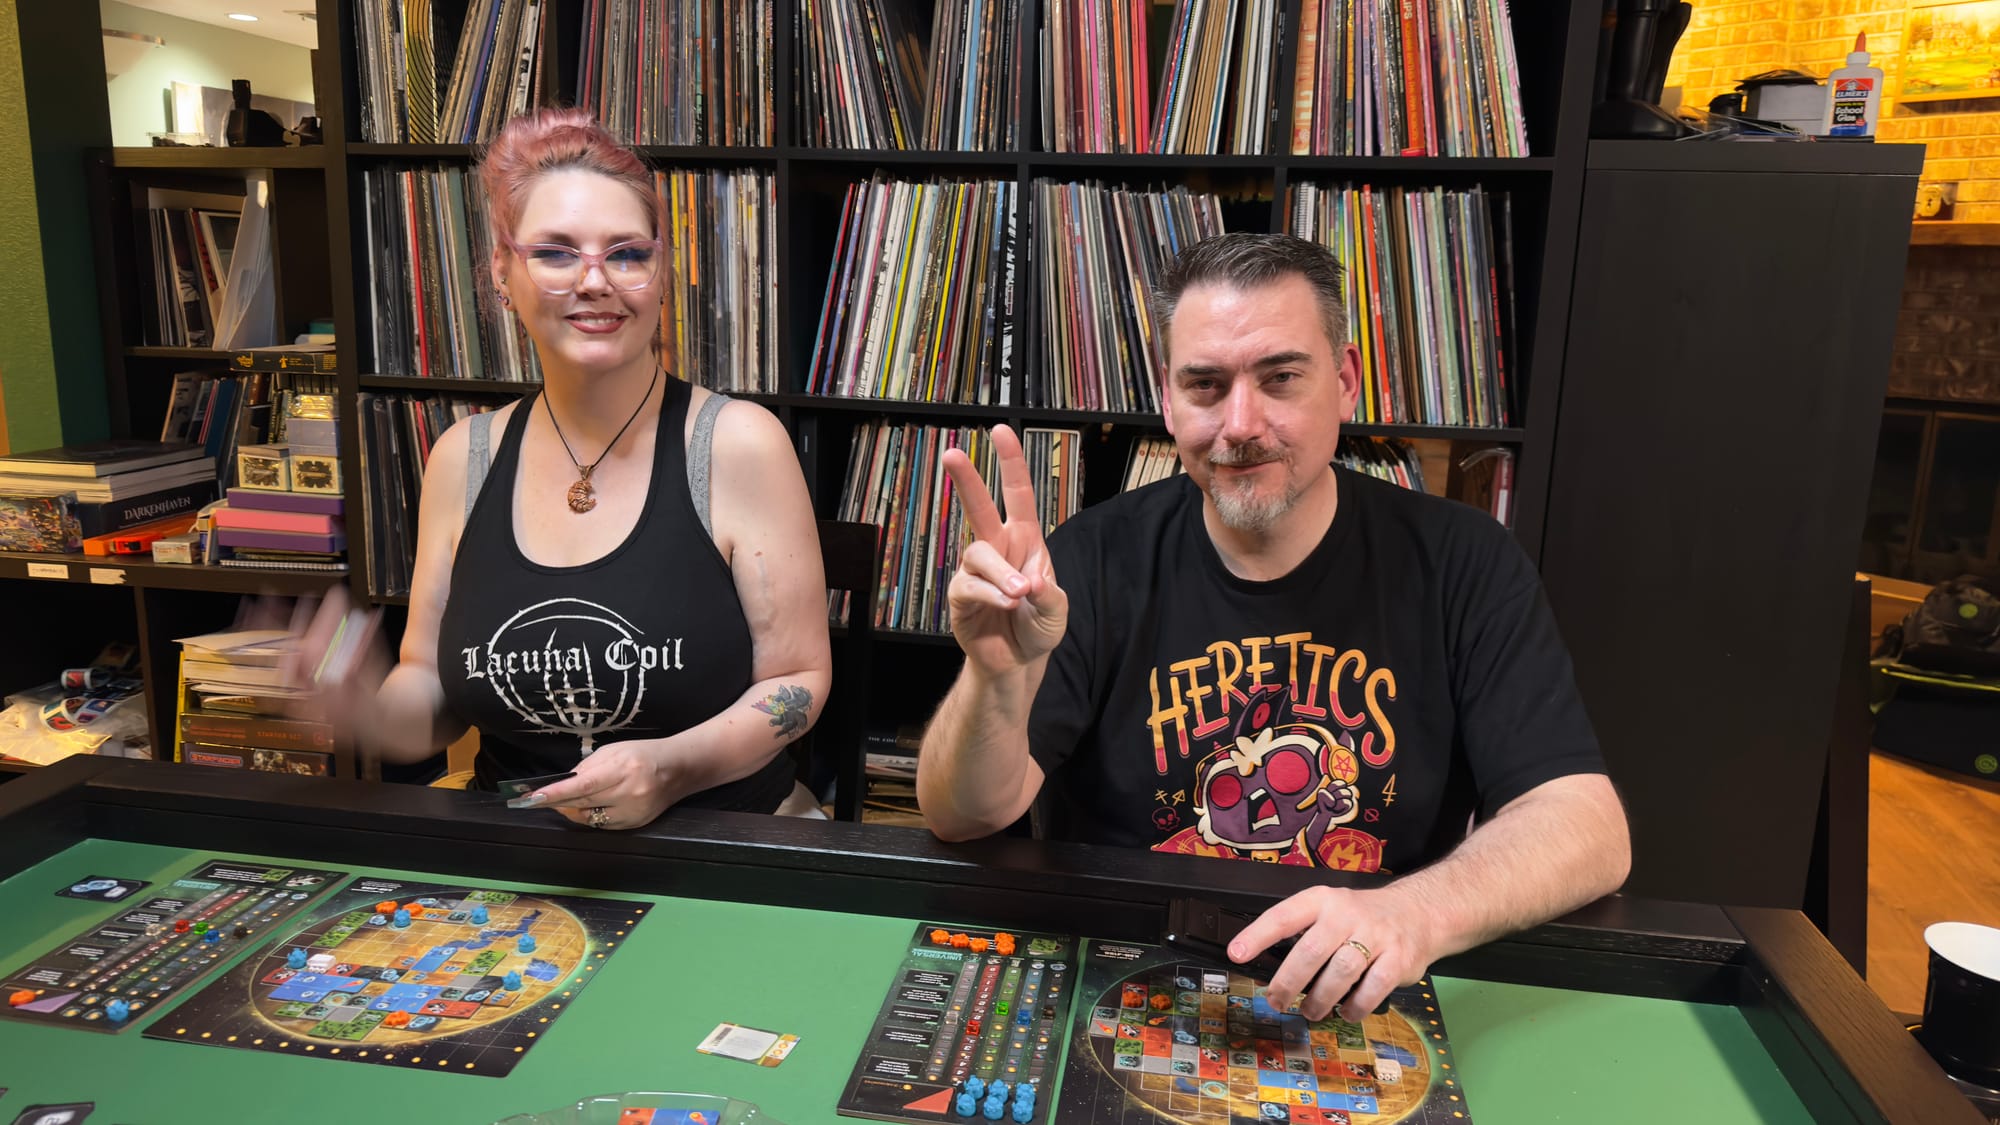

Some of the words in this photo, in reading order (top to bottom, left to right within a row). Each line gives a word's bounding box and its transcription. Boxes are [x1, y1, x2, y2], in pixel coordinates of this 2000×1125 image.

[1402, 0, 1413, 20] IPS
[1835, 106, 1864, 115] School
[1837, 114, 1856, 122] Glue
[124, 496, 191, 521] DARKENHAVEN
[461, 642, 583, 680] Lacuna
[605, 637, 685, 671] Coil
[1146, 631, 1398, 776] HERETICS
[911, 950, 962, 960] UNIVERSAL
